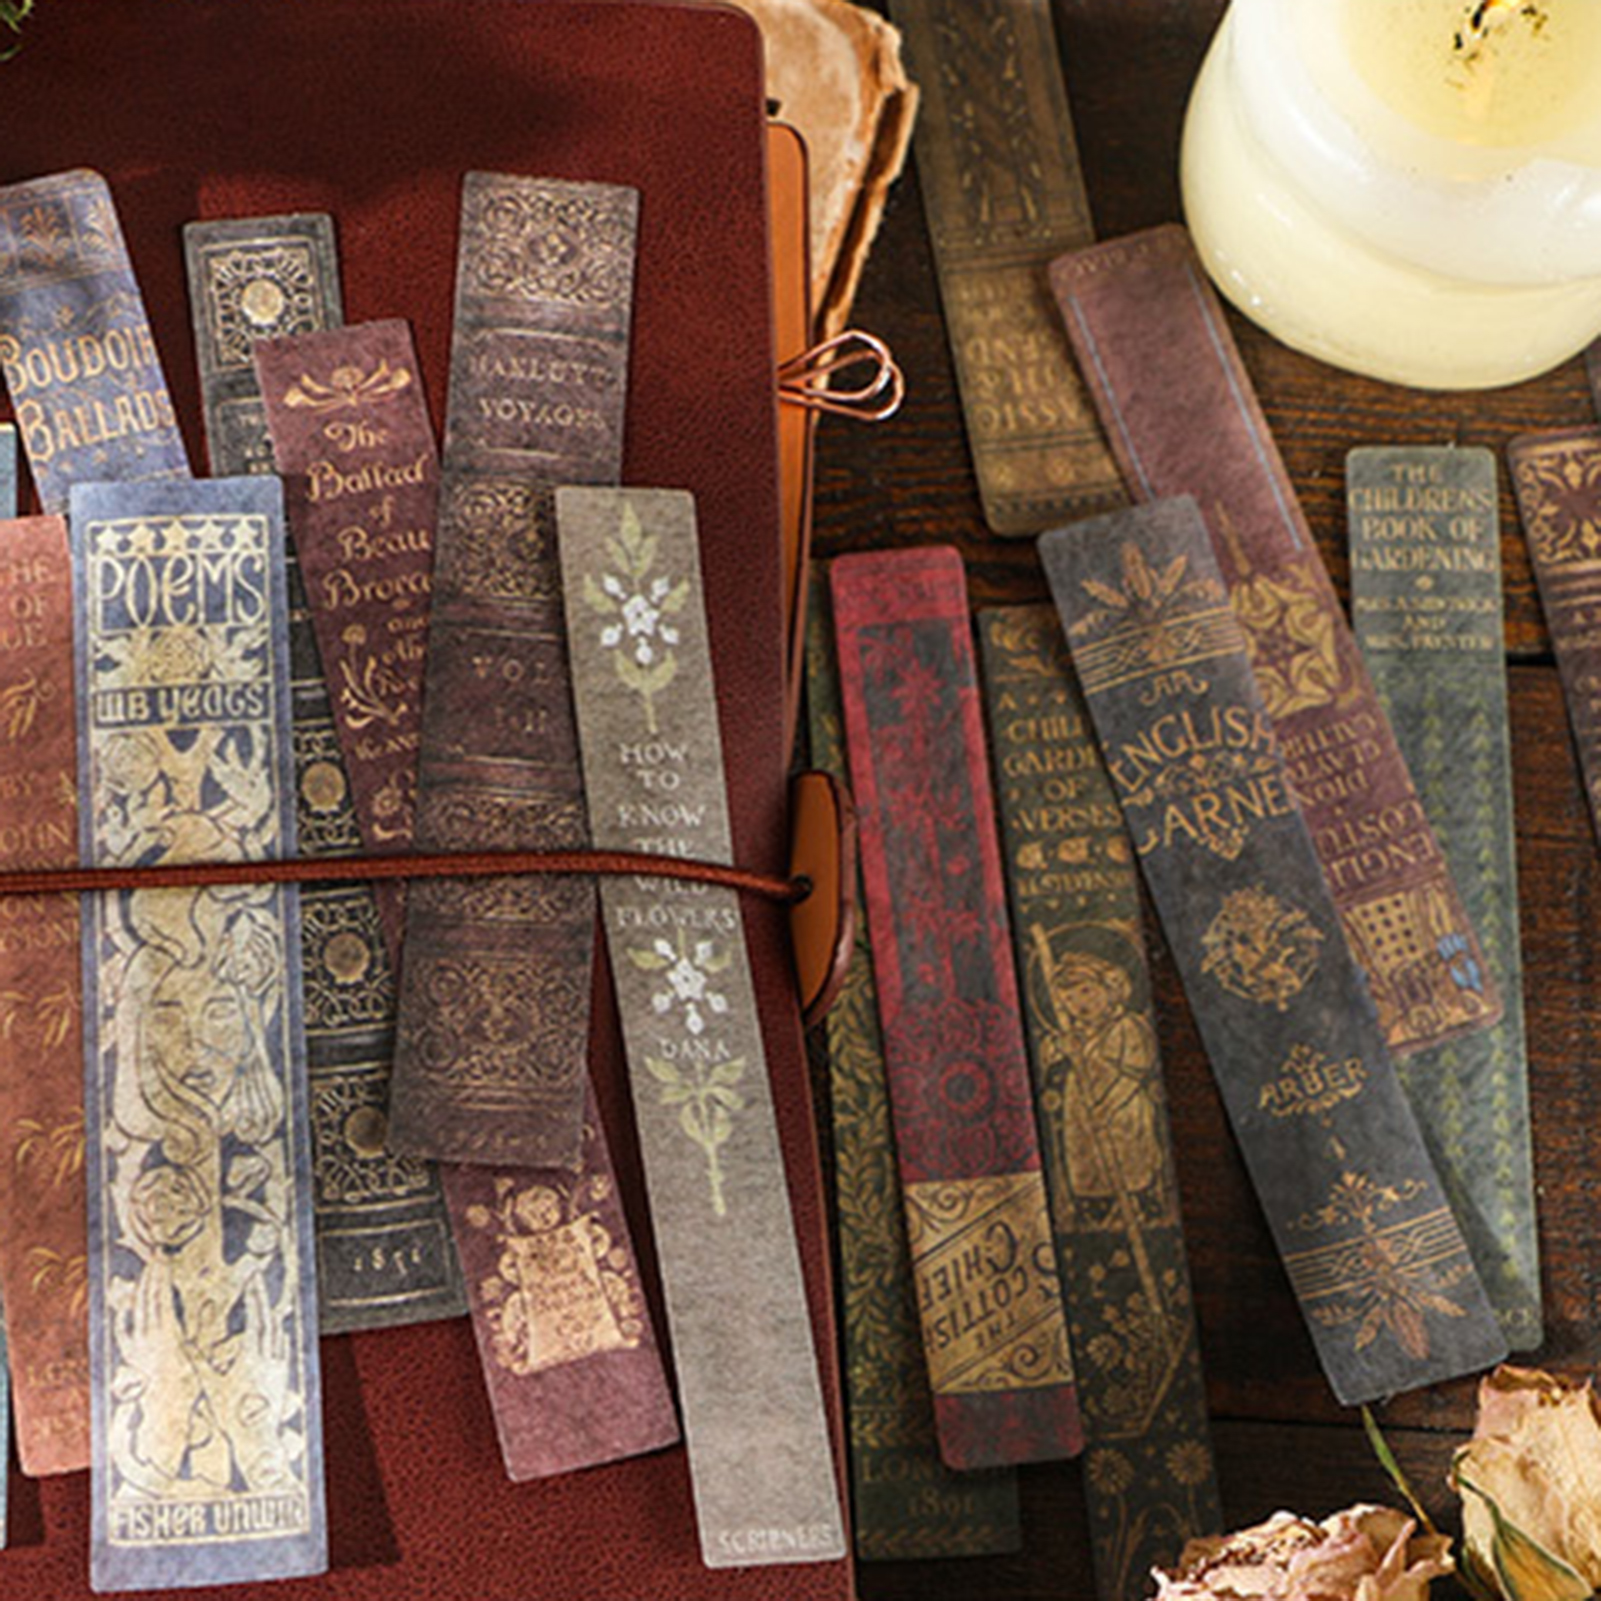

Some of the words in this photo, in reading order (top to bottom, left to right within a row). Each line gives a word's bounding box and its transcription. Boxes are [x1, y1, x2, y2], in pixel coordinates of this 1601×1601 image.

[16, 388, 175, 462] BALLADS
[323, 418, 389, 452] The
[305, 453, 428, 502] Ballad
[1391, 462, 1444, 485] THE
[370, 495, 395, 528] of
[1361, 516, 1438, 542] BOOK
[1448, 515, 1486, 542] OF
[337, 525, 432, 564] Beau
[98, 553, 267, 631] POEMS
[617, 742, 688, 765] HOW
[635, 767, 681, 789] TO
[616, 803, 707, 830] KNOW
[615, 904, 737, 933] FLOWERS
[658, 1039, 731, 1061] DANA
